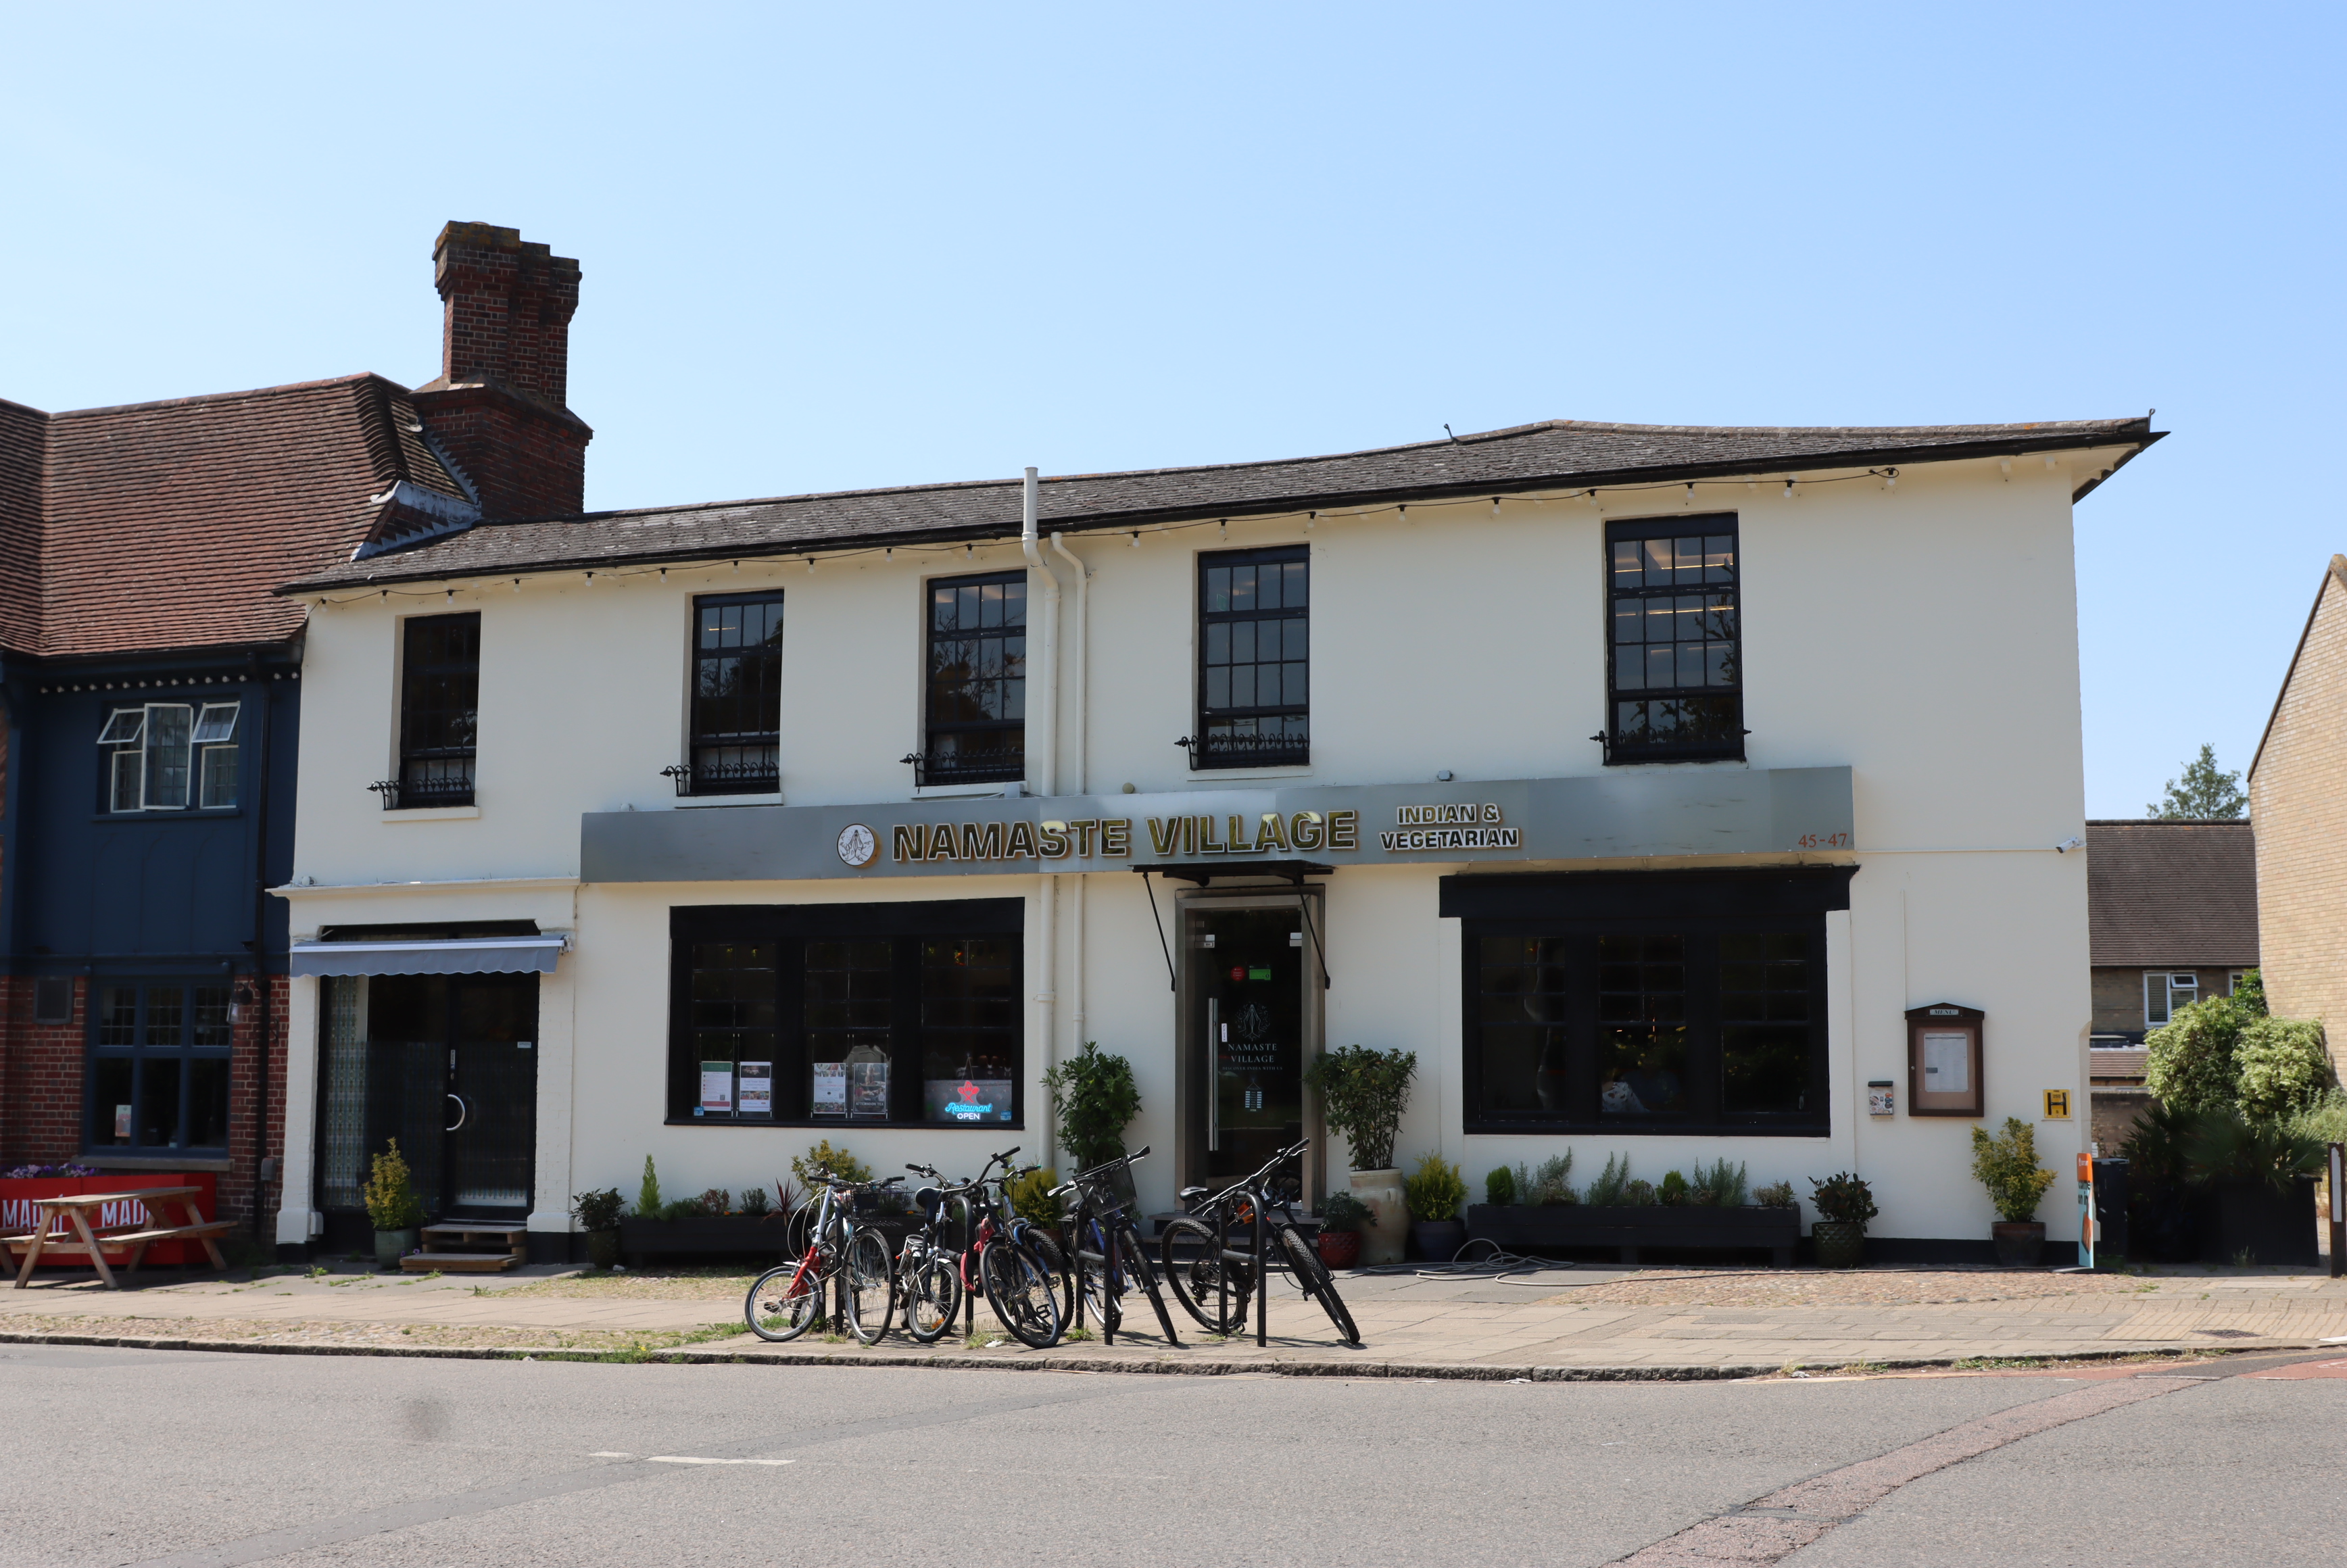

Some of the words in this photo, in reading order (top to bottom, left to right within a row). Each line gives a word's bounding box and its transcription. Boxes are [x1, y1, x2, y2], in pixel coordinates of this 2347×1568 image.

[1397, 803, 1478, 826] INDIAN
[1482, 802, 1502, 824] &
[892, 818, 1128, 862] NAMASTE
[1144, 810, 1357, 856] VILLAGE
[1379, 828, 1520, 851] VEGETARIAN
[1231, 1055, 1275, 1063] VILLAGE
[944, 1102, 993, 1114] Restaurant
